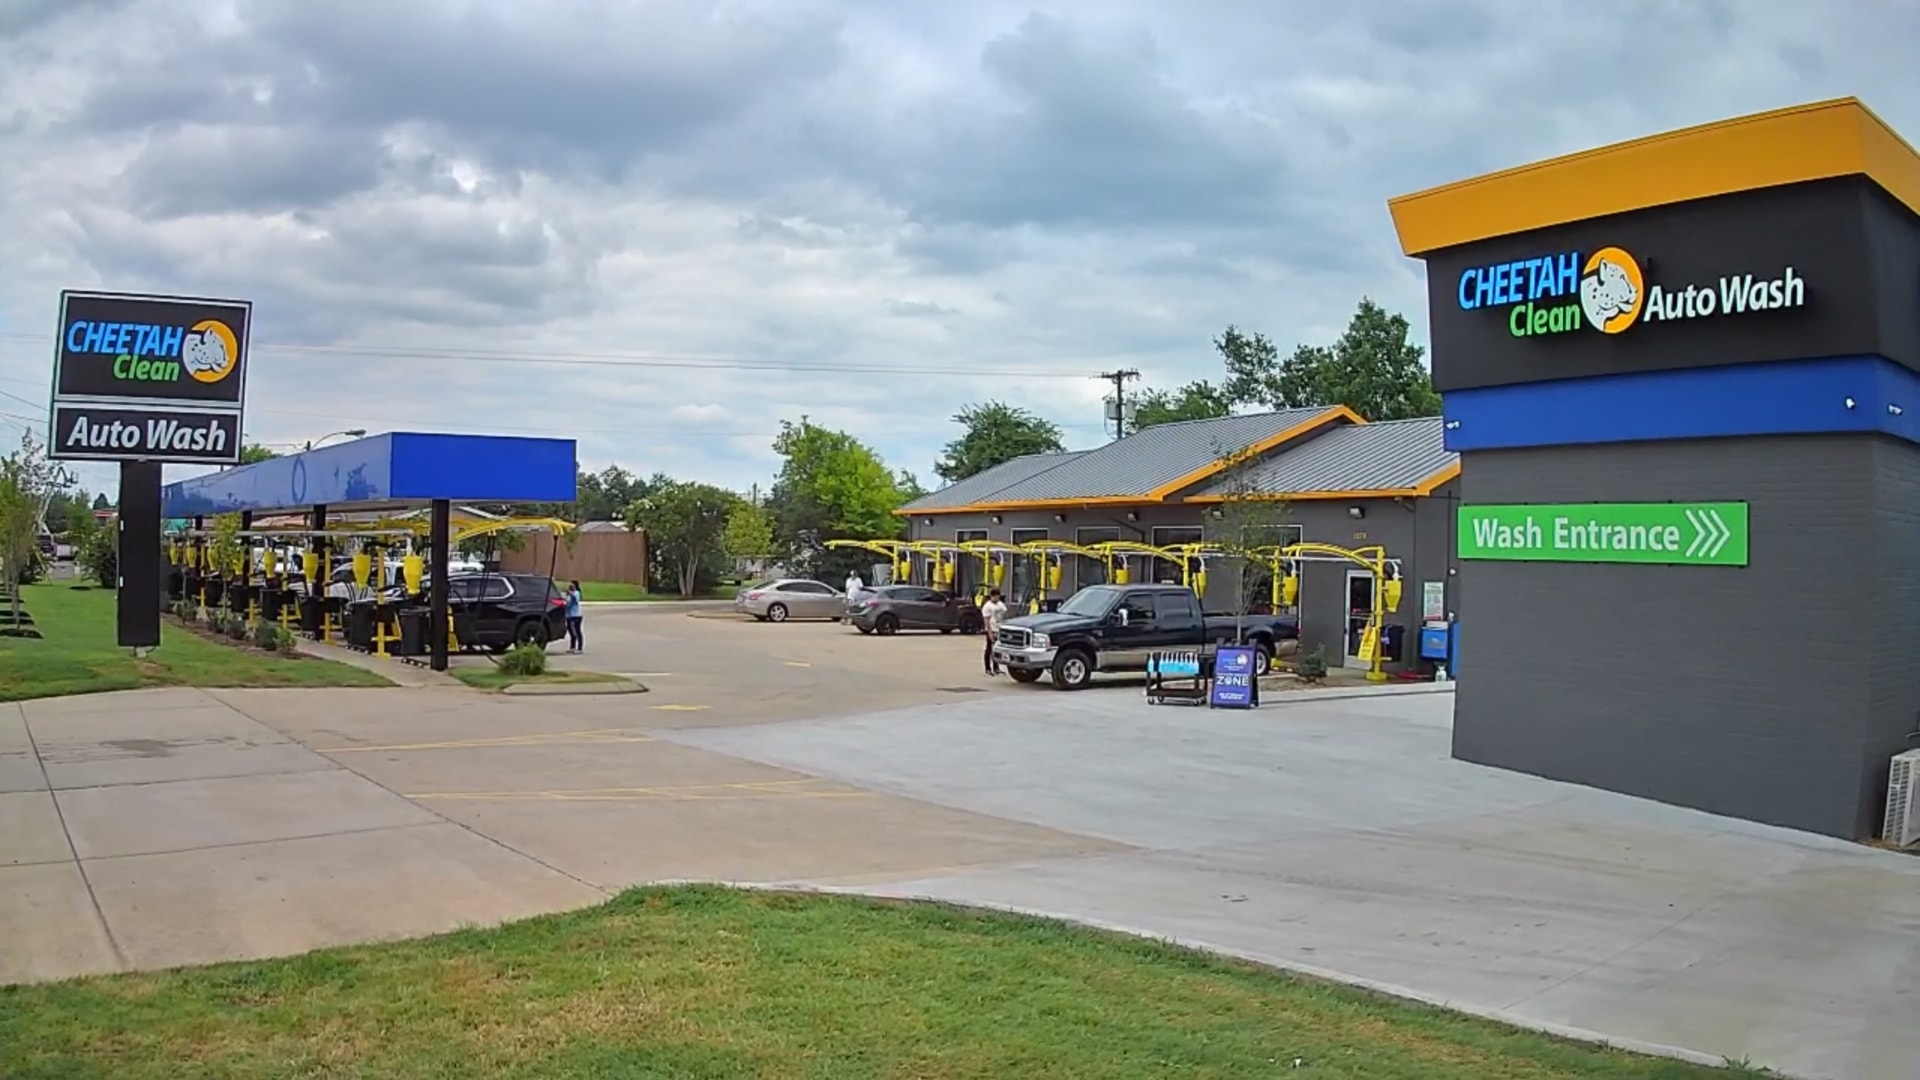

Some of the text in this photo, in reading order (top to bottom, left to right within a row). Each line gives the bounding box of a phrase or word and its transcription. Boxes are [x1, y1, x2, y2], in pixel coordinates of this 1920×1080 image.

[1458, 251, 1580, 310] CHEETAH
[1644, 267, 1805, 321] Auto Wash
[1510, 303, 1580, 336] Clean
[68, 321, 183, 356] CHEETAH
[113, 355, 180, 381] Clean
[66, 416, 226, 451] Auto Wash
[1473, 516, 1680, 551] Wash Entrance
[1217, 676, 1249, 687] ZONE
